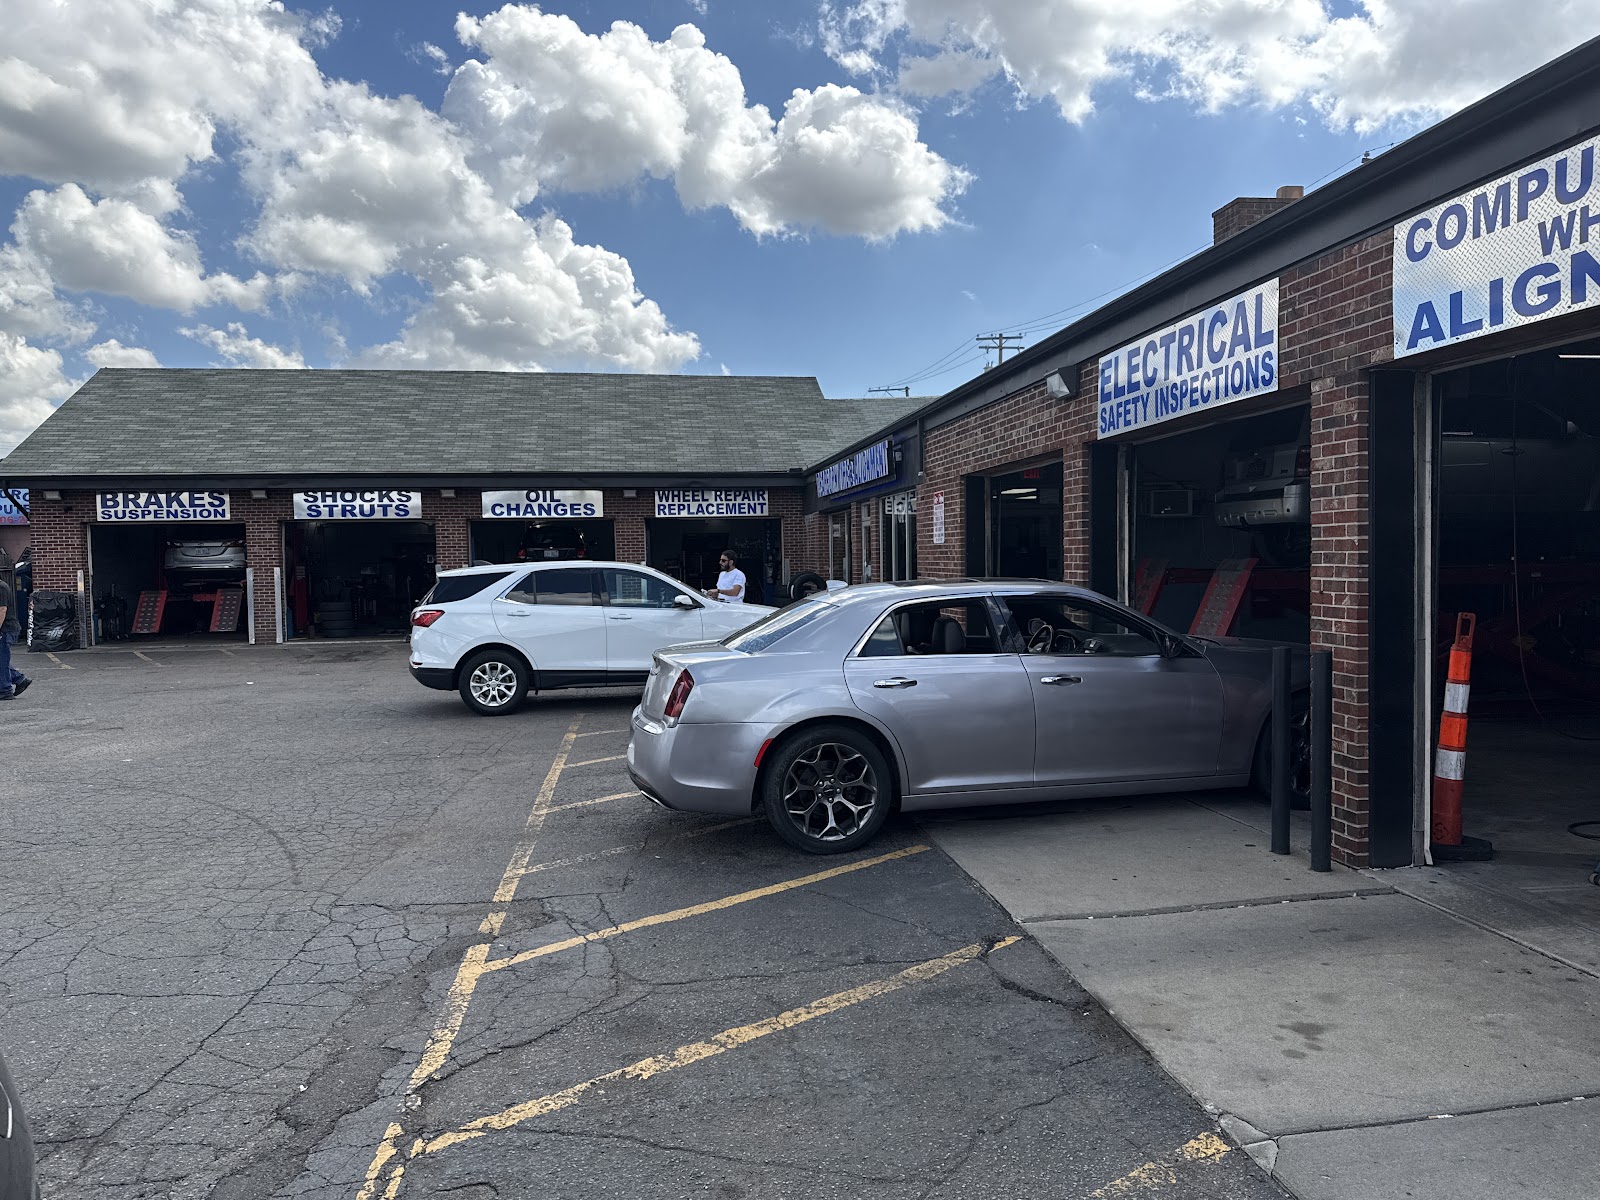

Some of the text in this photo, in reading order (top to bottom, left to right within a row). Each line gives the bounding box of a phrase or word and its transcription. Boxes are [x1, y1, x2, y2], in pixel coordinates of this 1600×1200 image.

[1405, 145, 1594, 262] COMPU
[1406, 250, 1600, 350] ALIGN
[1100, 293, 1274, 404] ELECTRICAL
[1100, 350, 1274, 434] SAFETY INSPECTIONS
[100, 490, 226, 509] BRAKES
[303, 490, 412, 503] SHOCKS
[525, 490, 561, 502] OIL
[657, 490, 766, 502] WHEEL REPAIR
[101, 509, 225, 520] SUSPENSION
[306, 504, 410, 517] STRUTS
[491, 503, 596, 516] CHANGES
[657, 502, 766, 515] REPLACEMENT
